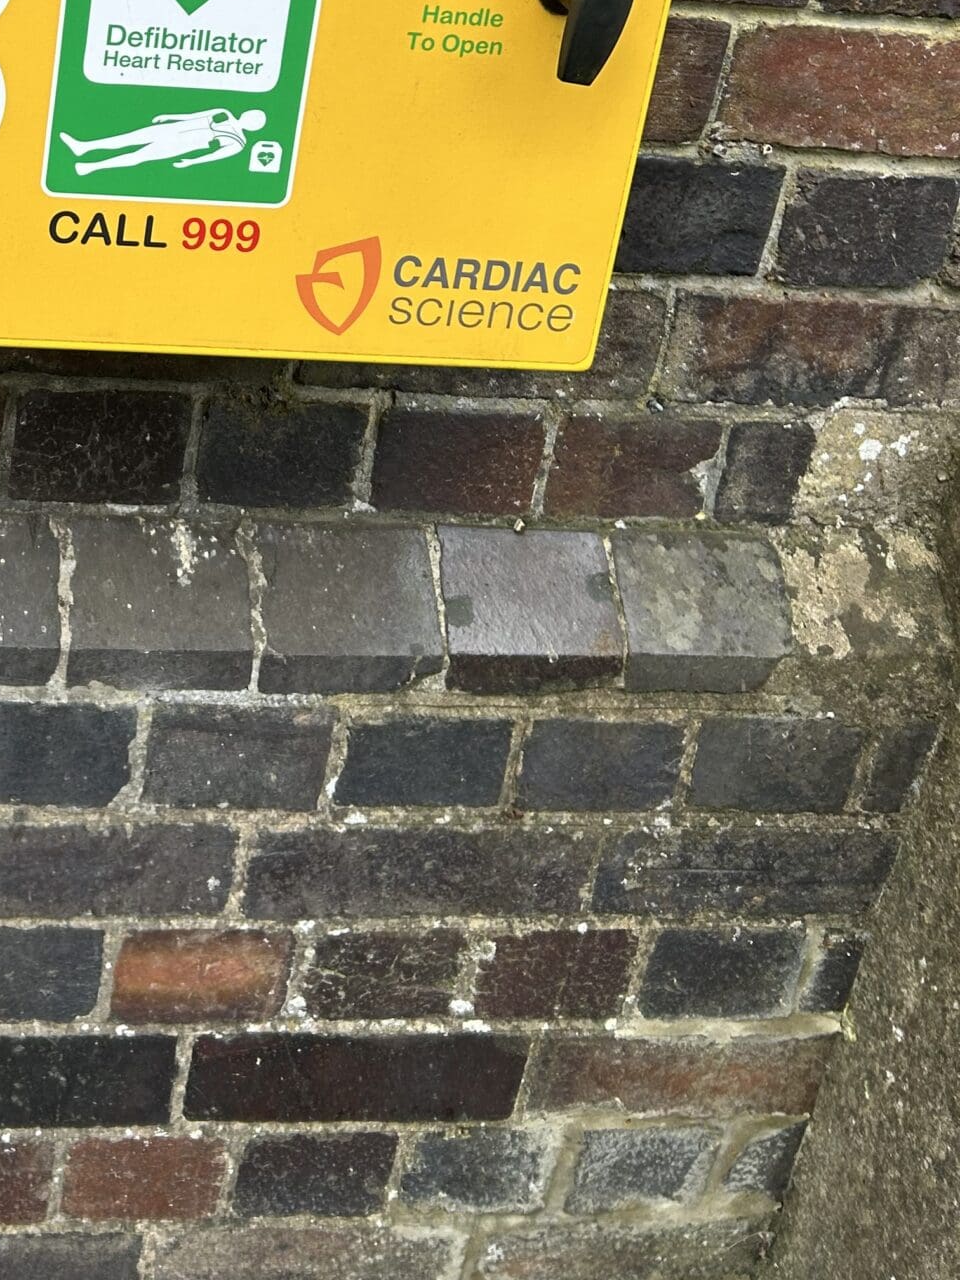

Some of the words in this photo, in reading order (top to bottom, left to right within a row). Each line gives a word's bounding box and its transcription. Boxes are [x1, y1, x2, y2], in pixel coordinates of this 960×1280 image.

[422, 5, 504, 28] Handle
[106, 24, 267, 55] Defibrillator
[407, 32, 435, 51] To
[442, 34, 503, 58] Open
[103, 50, 161, 70] Heart
[167, 54, 263, 76] Restarter
[49, 210, 167, 249] CALL
[181, 217, 261, 254] 999
[393, 255, 582, 296] CARDIAC
[388, 295, 574, 334] science
